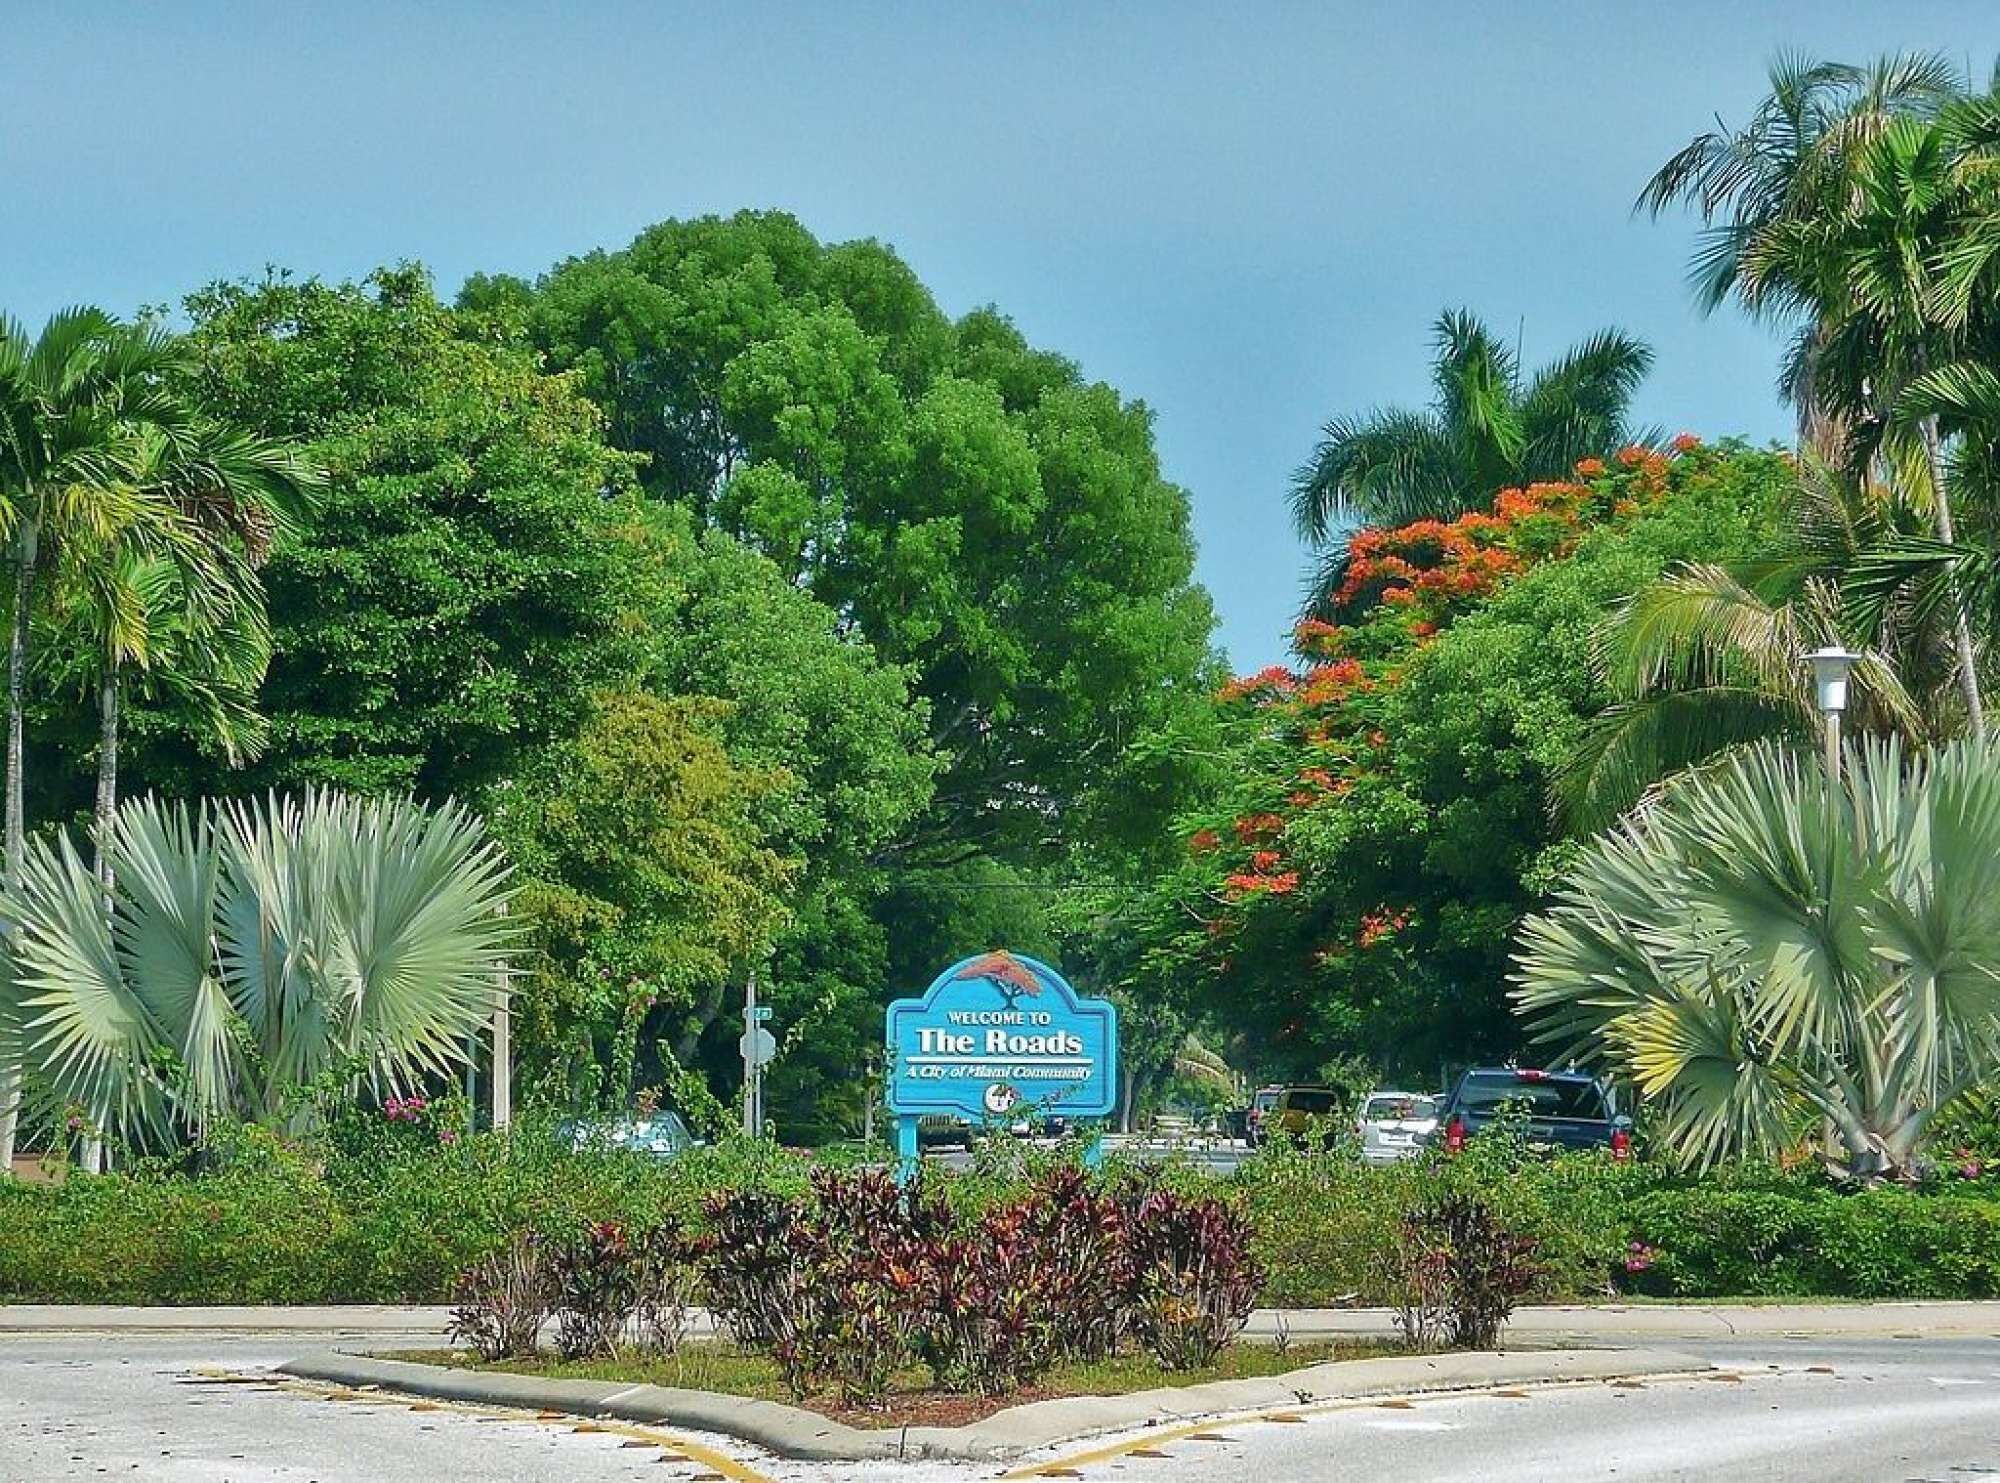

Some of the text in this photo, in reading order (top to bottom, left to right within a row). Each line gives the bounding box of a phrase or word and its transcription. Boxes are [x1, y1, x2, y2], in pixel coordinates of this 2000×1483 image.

[948, 1011, 1051, 1025] WELCOME TO
[916, 1028, 1083, 1055] The Roads
[904, 1065, 1094, 1081] A City of Miami Community
